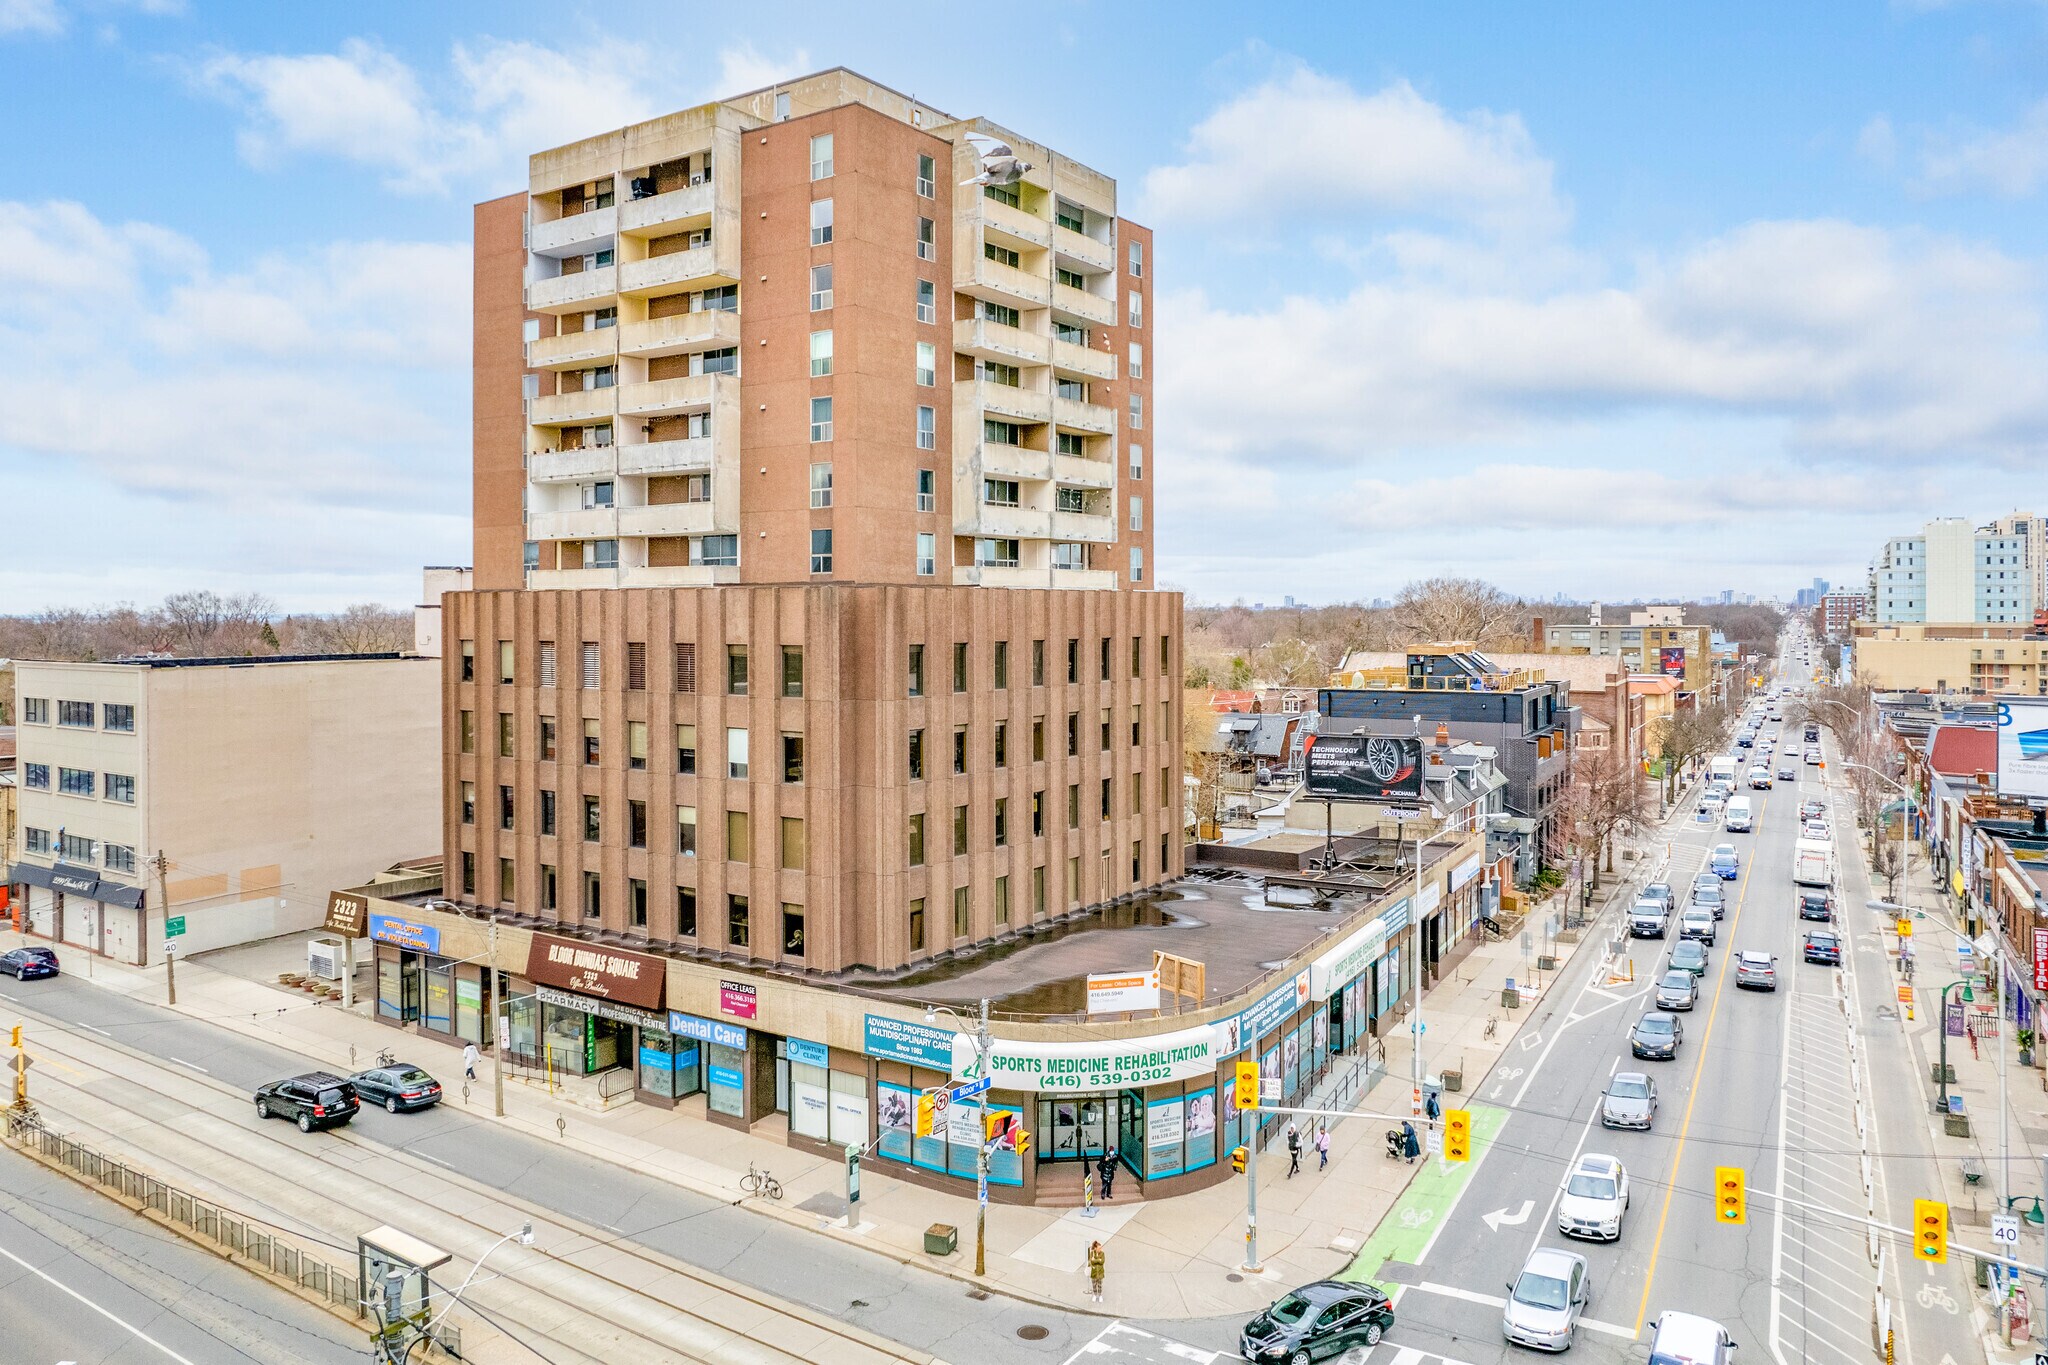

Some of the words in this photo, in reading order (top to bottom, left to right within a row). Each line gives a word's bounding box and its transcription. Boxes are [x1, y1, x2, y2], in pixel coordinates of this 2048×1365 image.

[1311, 746, 1359, 754] TECHNOLOGY
[333, 899, 358, 917] 2323
[383, 920, 403, 931] DENTAL
[404, 925, 423, 935] OFFICE
[165, 944, 177, 952] 40
[548, 944, 575, 966] BLOOR
[573, 949, 608, 973] DUNDAS
[606, 956, 641, 980] SQUARE
[2035, 935, 2048, 990] HOSPITAL
[583, 971, 599, 981] 2323
[569, 976, 586, 990] Office
[584, 980, 610, 998] Building
[721, 981, 739, 992] OFFICE
[739, 985, 756, 995] LEASE
[1241, 1000, 1267, 1022] ADVANCED
[1266, 979, 1295, 1006] PROFESSIONAL
[1283, 988, 1295, 1002] CARE
[540, 993, 596, 1012] PHARMACY
[614, 1005, 646, 1017] MEDICAL
[600, 1007, 642, 1025] PROFESSIONAL
[642, 1018, 667, 1031] CENTRE
[672, 1014, 711, 1039] Dental
[714, 1024, 744, 1047] Care
[867, 1017, 902, 1032] ADVANCED
[903, 1024, 953, 1042] PROFESSIONAL
[869, 1026, 932, 1048] MULTIDISCIPLINARY
[932, 1041, 952, 1052] CARE
[799, 1043, 826, 1054] DENTURE
[896, 1043, 910, 1053] Since
[802, 1052, 822, 1061] CLINIC
[991, 1055, 1042, 1073] SPORTS
[1047, 1057, 1109, 1073] MEDICINE
[1114, 1042, 1209, 1071] REHABILITATION
[1039, 1075, 1082, 1089] (416)
[1089, 1066, 1172, 1086] 539-0302
[959, 1085, 975, 1097] Bloor
[979, 1080, 985, 1089] W
[950, 1119, 963, 1127] SPORTS
[1150, 1118, 1164, 1126] SPORTS
[1164, 1115, 1181, 1123] MEDICINE
[1151, 1121, 1180, 1130] REHABILITATION
[951, 1125, 980, 1134] REHABILITATION
[1993, 1217, 2017, 1226] MAXIMUM
[1994, 1227, 2017, 1241] 40
